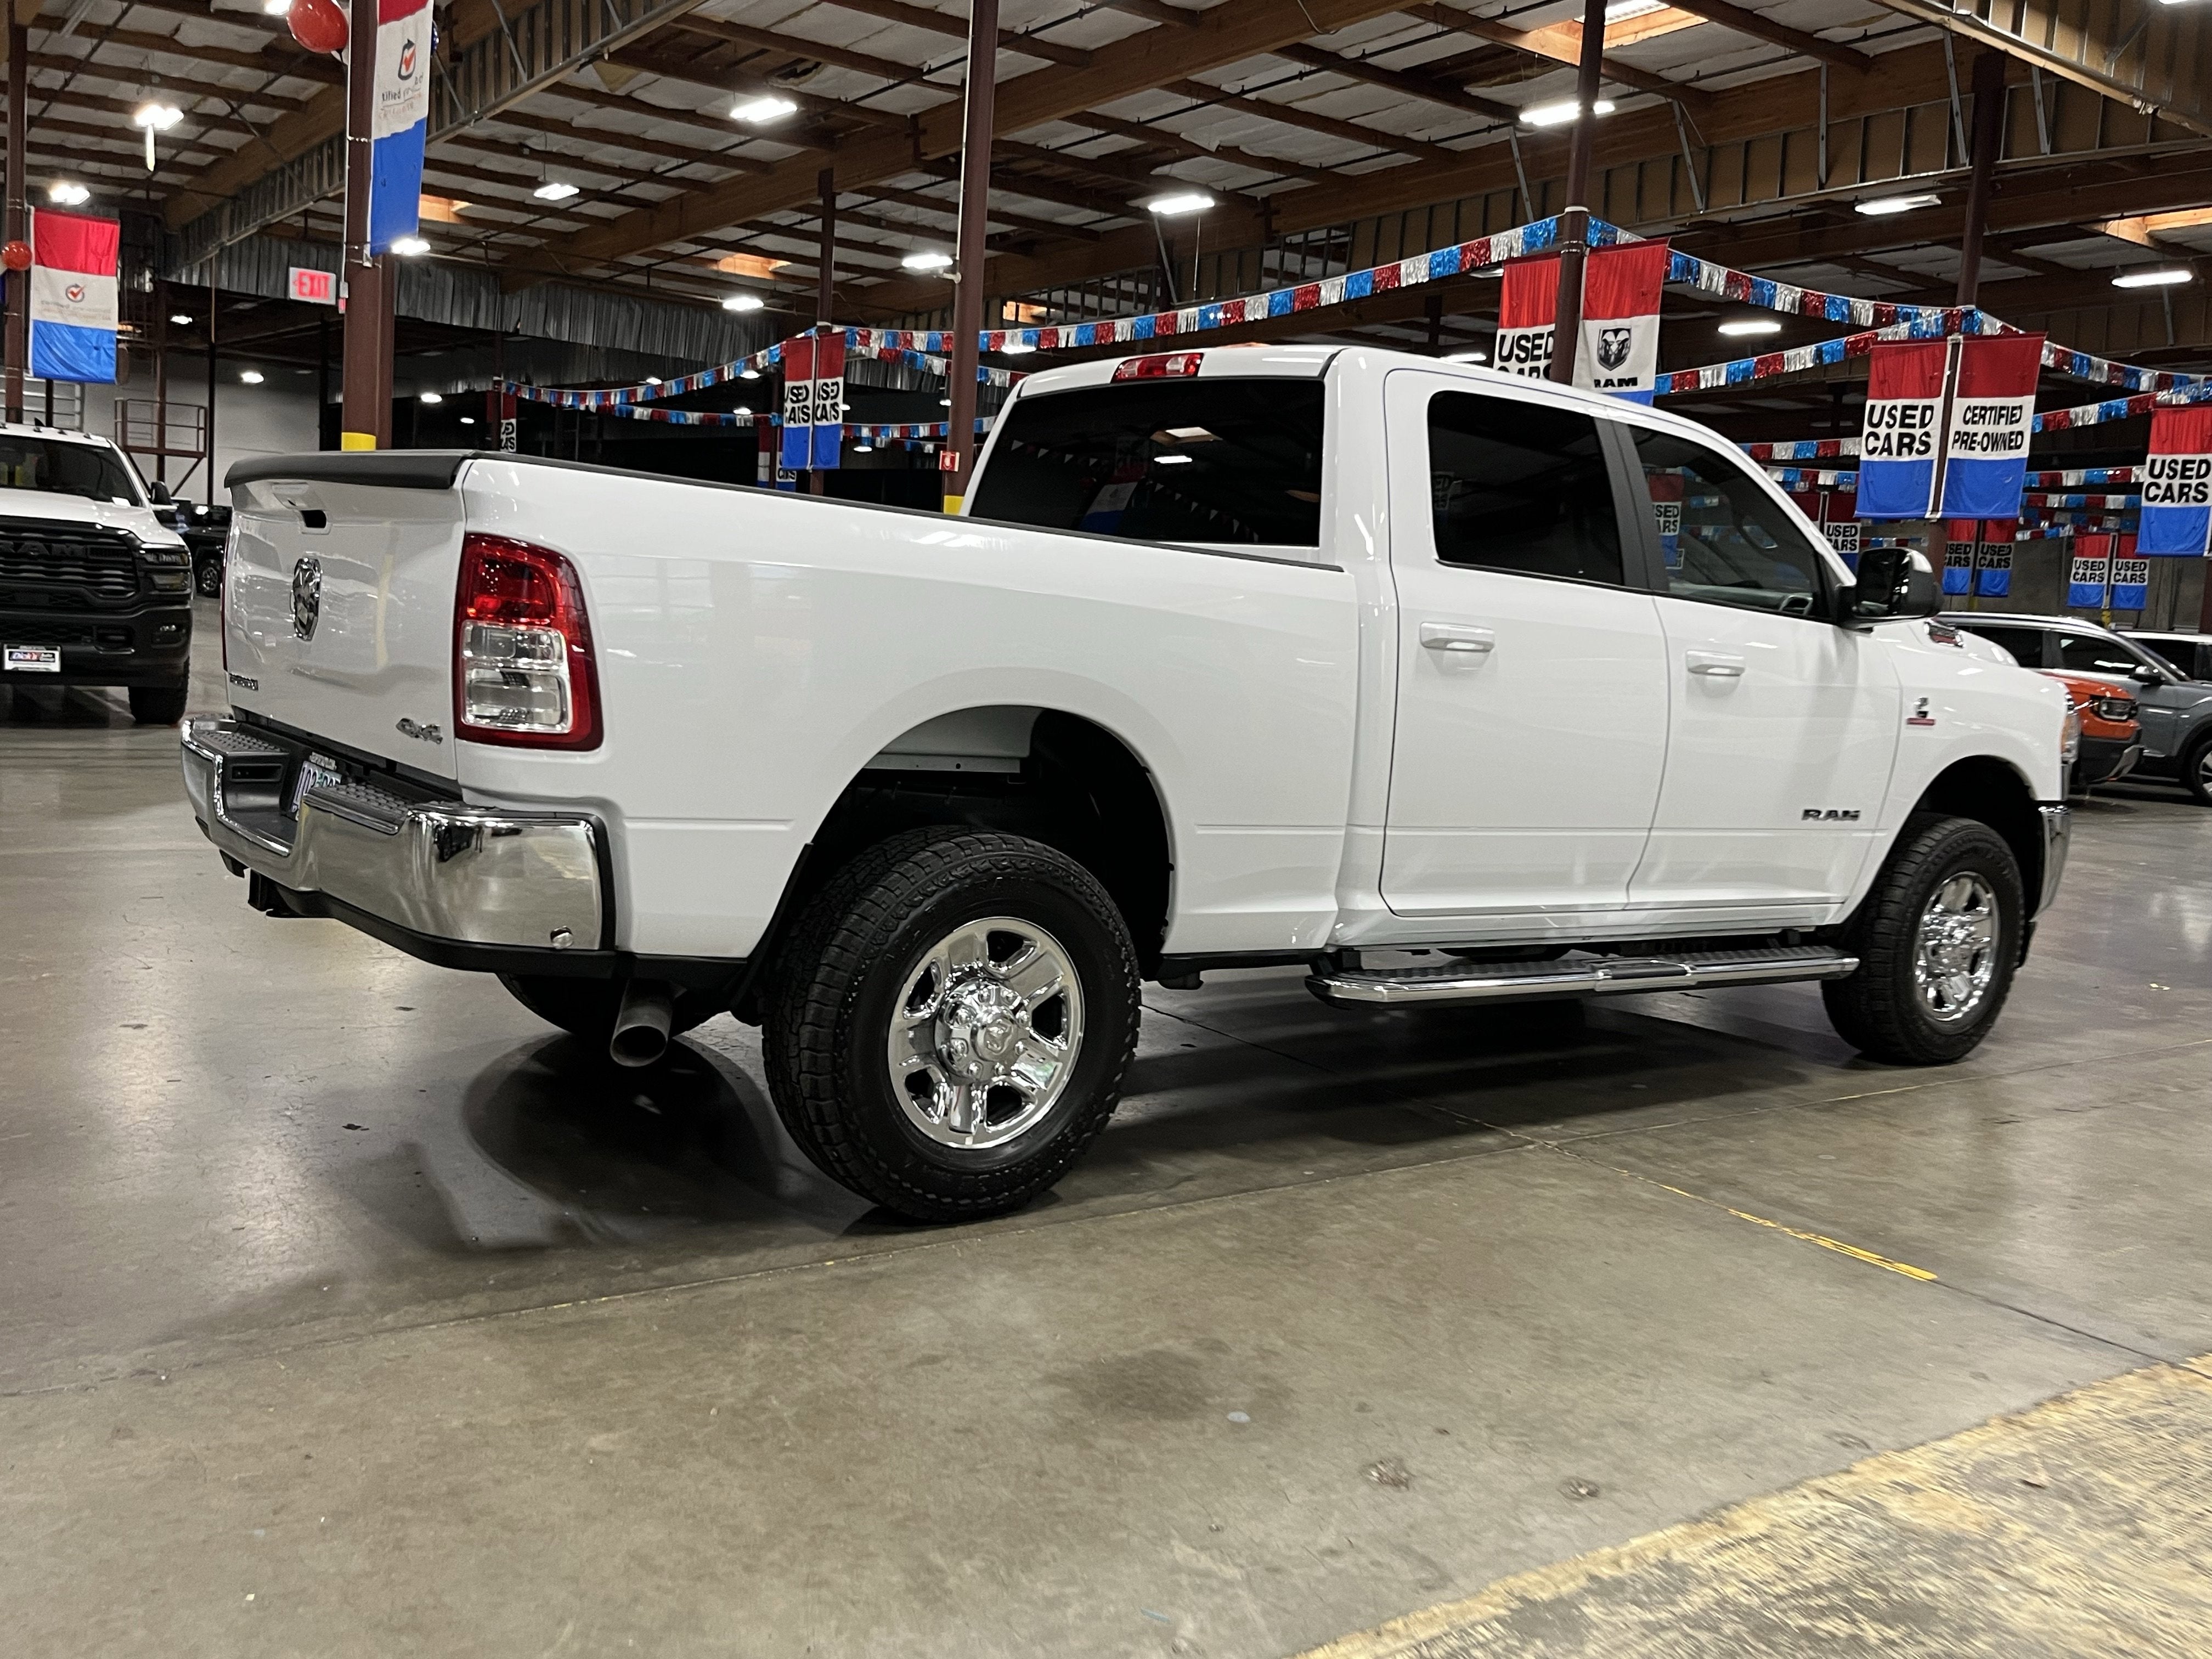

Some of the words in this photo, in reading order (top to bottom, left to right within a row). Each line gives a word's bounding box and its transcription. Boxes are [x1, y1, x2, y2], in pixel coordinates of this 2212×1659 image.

[298, 271, 330, 301] EXIT
[1498, 330, 1555, 364] USED
[1593, 377, 1638, 388] RAM
[1867, 405, 1934, 429] USED
[1962, 404, 2023, 425] CERTIFIED
[1865, 431, 1932, 456] CARS
[1951, 431, 2024, 452] PRE-OWNED
[2148, 458, 2211, 480] USED
[2144, 482, 2209, 503] CARS
[1653, 504, 1679, 518] SED
[1826, 524, 1858, 538] USED
[1946, 543, 1972, 555] SED
[1980, 544, 2012, 556] USED
[1945, 556, 1971, 567] ARS
[1978, 556, 2011, 568] CARS
[2074, 560, 2105, 571] USED
[2115, 561, 2147, 572] USED
[2073, 571, 2105, 583] CARS
[2113, 572, 2146, 583] CARS
[1801, 809, 1861, 822] RAM
